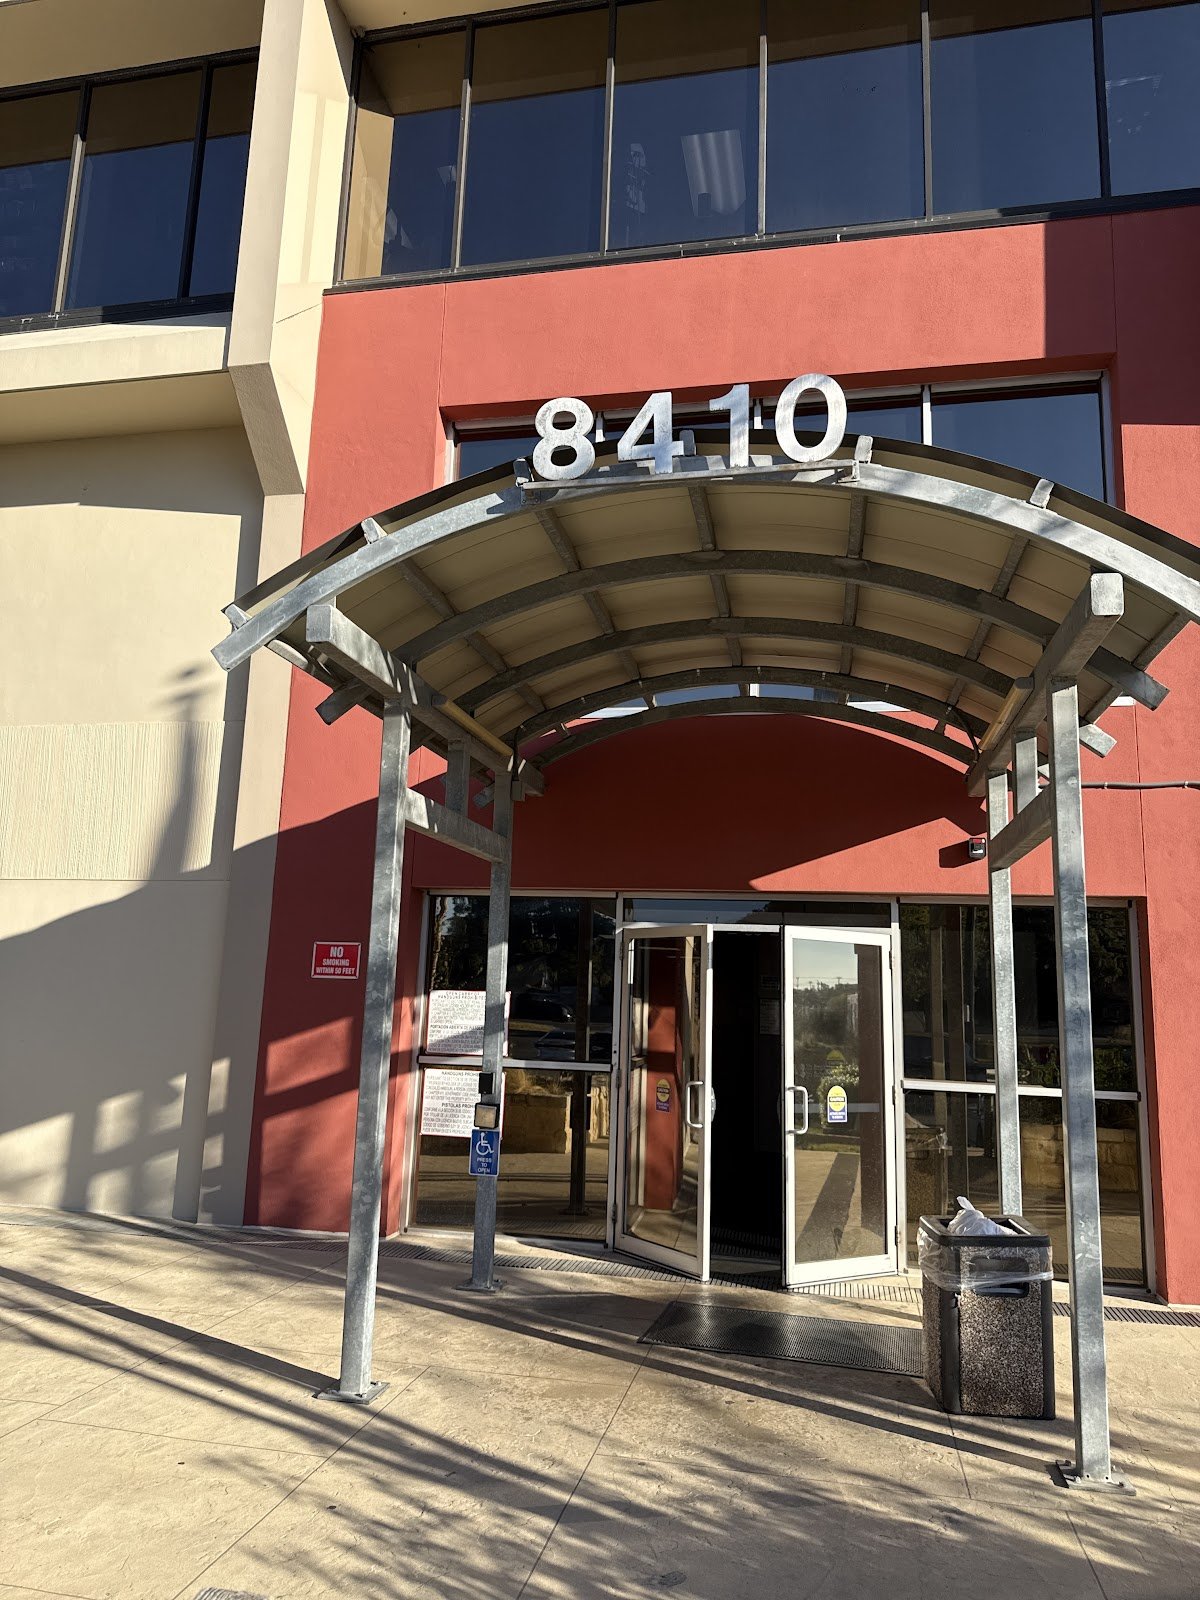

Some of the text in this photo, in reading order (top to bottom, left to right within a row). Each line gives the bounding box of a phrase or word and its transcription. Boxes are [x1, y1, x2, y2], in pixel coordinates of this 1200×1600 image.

[532, 372, 848, 481] 8410
[330, 946, 343, 957] NO
[322, 958, 349, 966] SMOKING
